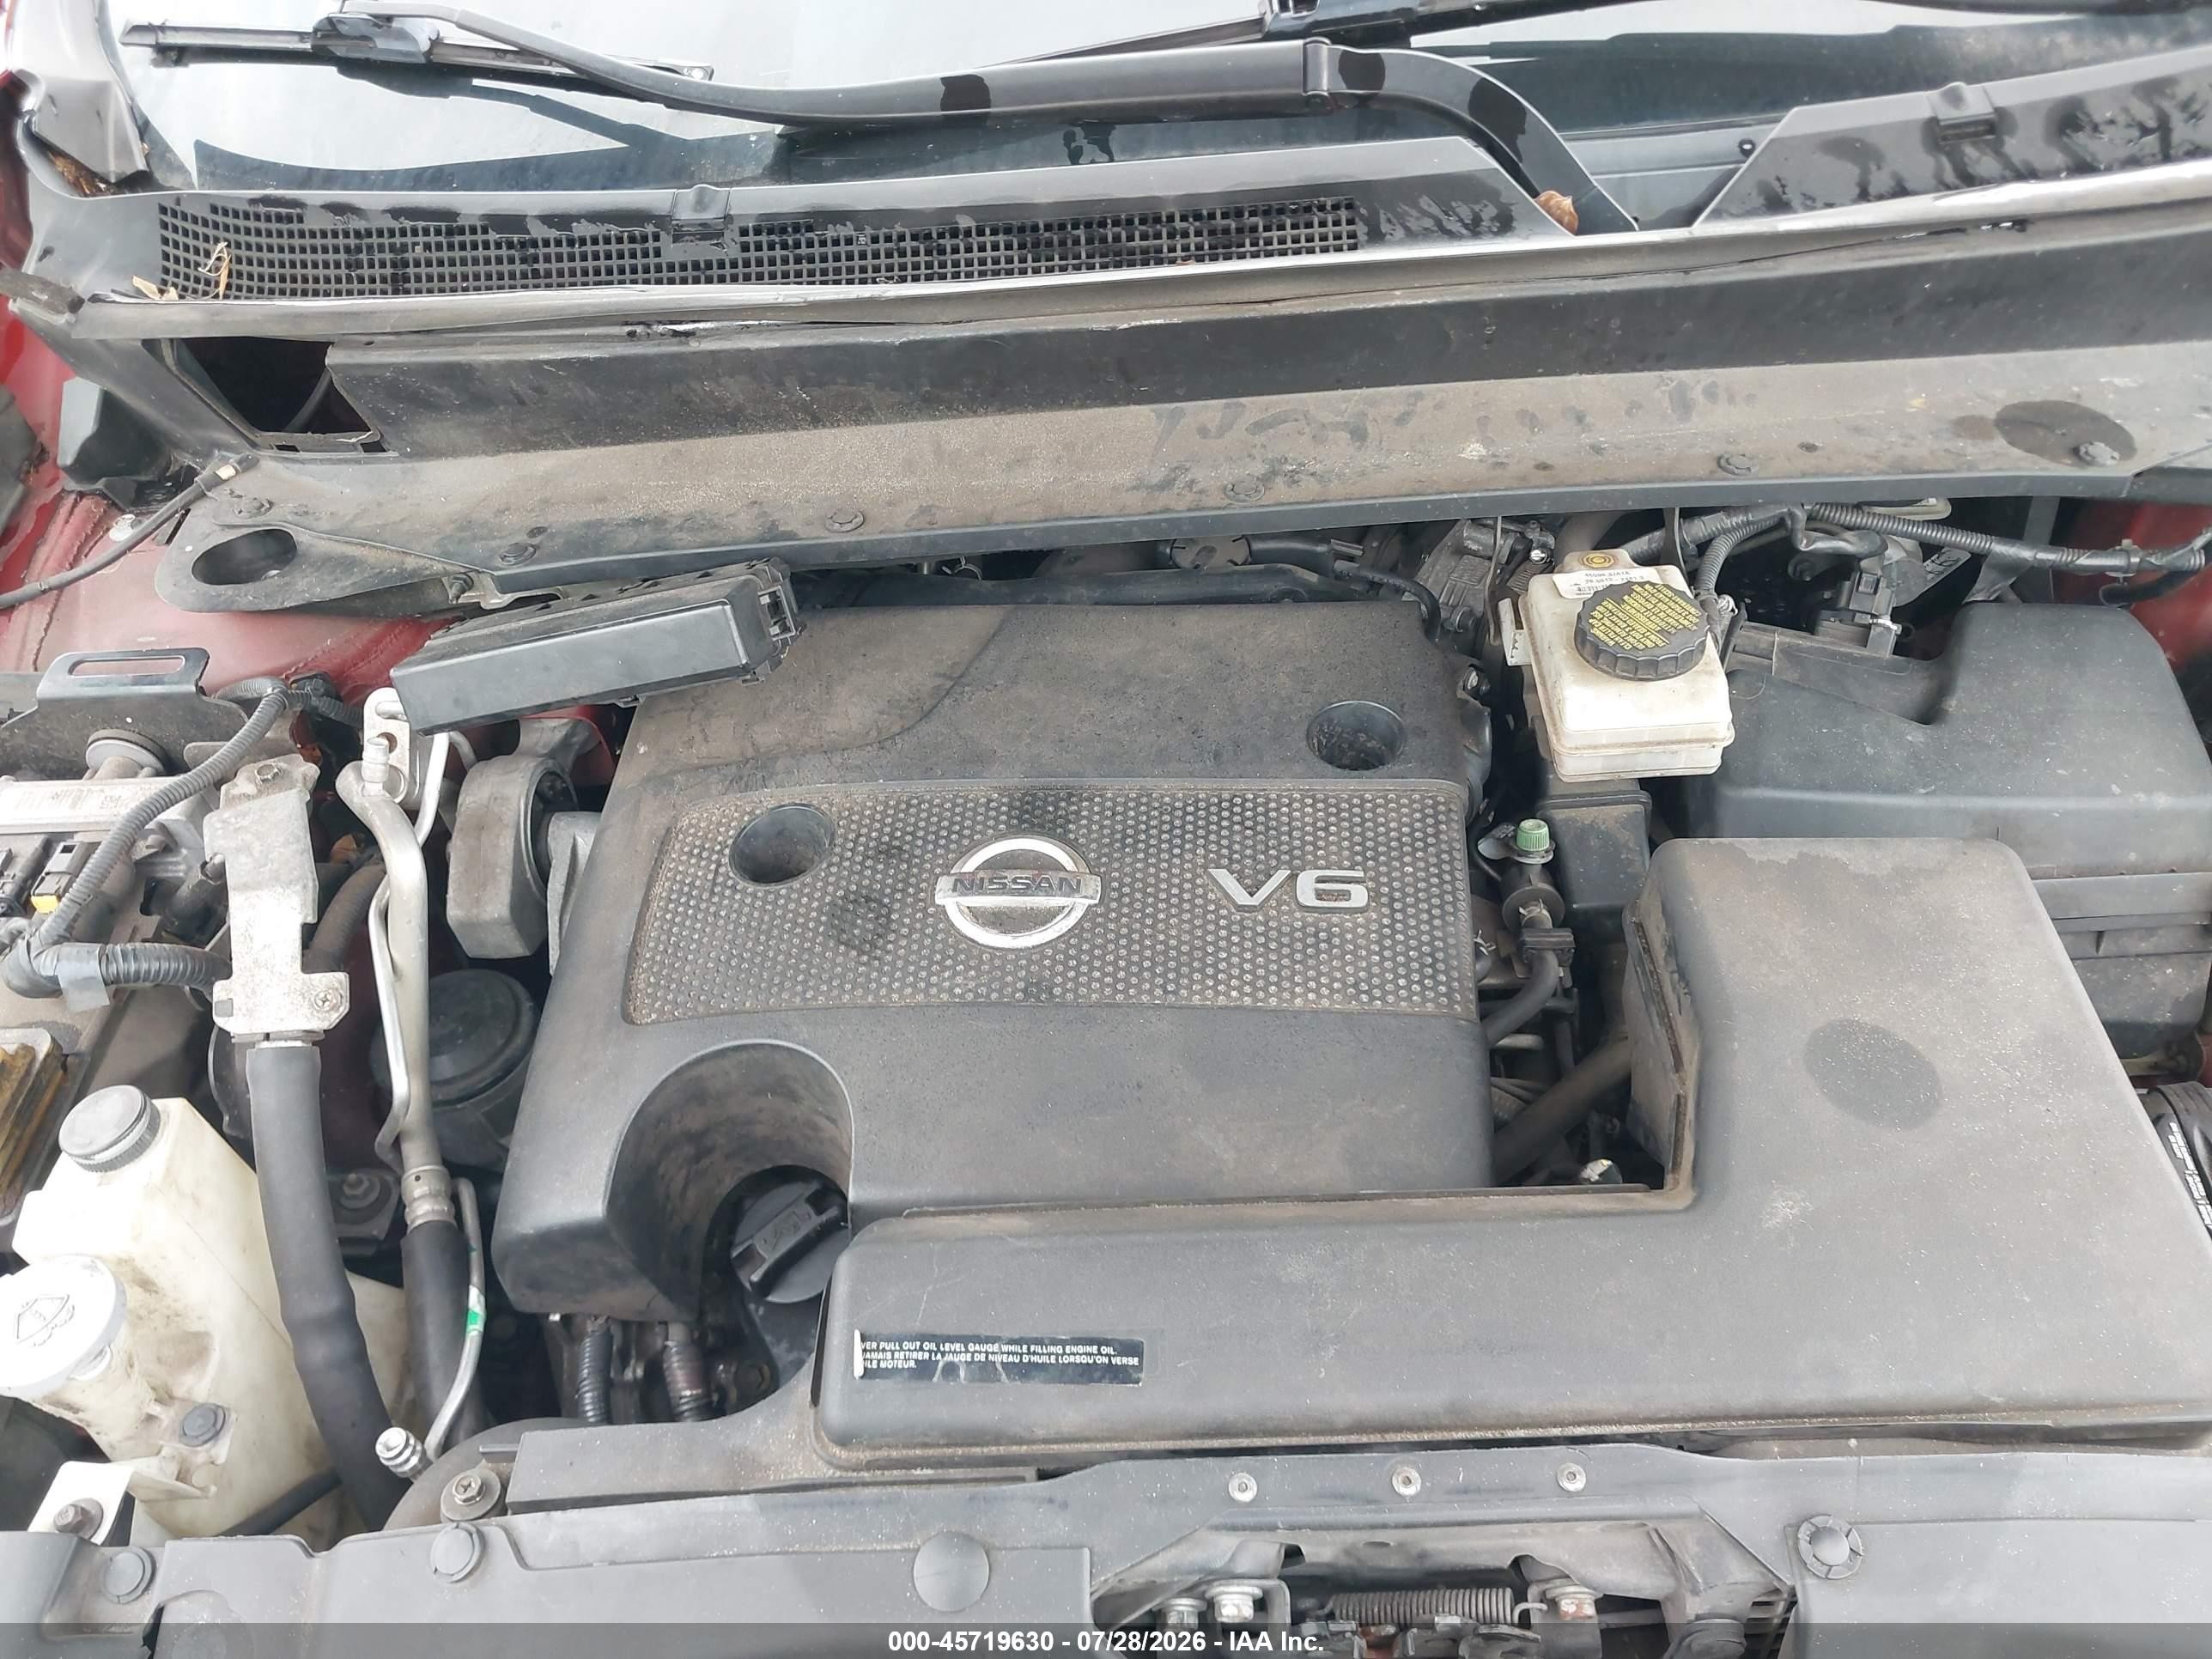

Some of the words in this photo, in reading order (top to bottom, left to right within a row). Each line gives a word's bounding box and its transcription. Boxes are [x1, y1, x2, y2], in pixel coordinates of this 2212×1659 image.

[951, 874, 1083, 895] NISSAN
[1207, 868, 1368, 908] V6
[860, 1341, 877, 1350] VER
[879, 1341, 900, 1350] PULL
[902, 1341, 921, 1351] OUT
[923, 1342, 937, 1351] OIL
[939, 1342, 965, 1352] LEVEL
[968, 1343, 999, 1352] GAUGE
[1000, 1344, 1028, 1353] WHILE
[1030, 1345, 1063, 1354] FILLING
[1066, 1346, 1097, 1354] ENGINE
[1100, 1346, 1118, 1355] OIL.
[879, 1359, 917, 1369] MOTEUR.
[894, 1352, 929, 1360] RETIRER
[932, 1352, 941, 1361] LA
[944, 1352, 971, 1361] JAUGE
[974, 1352, 987, 1362] DE
[988, 1353, 1022, 1363] NIVEAU
[1023, 1354, 1056, 1364] D'HUILE
[1058, 1355, 1109, 1364] LORSQU'ON
[1110, 1357, 1139, 1365] VERSE
